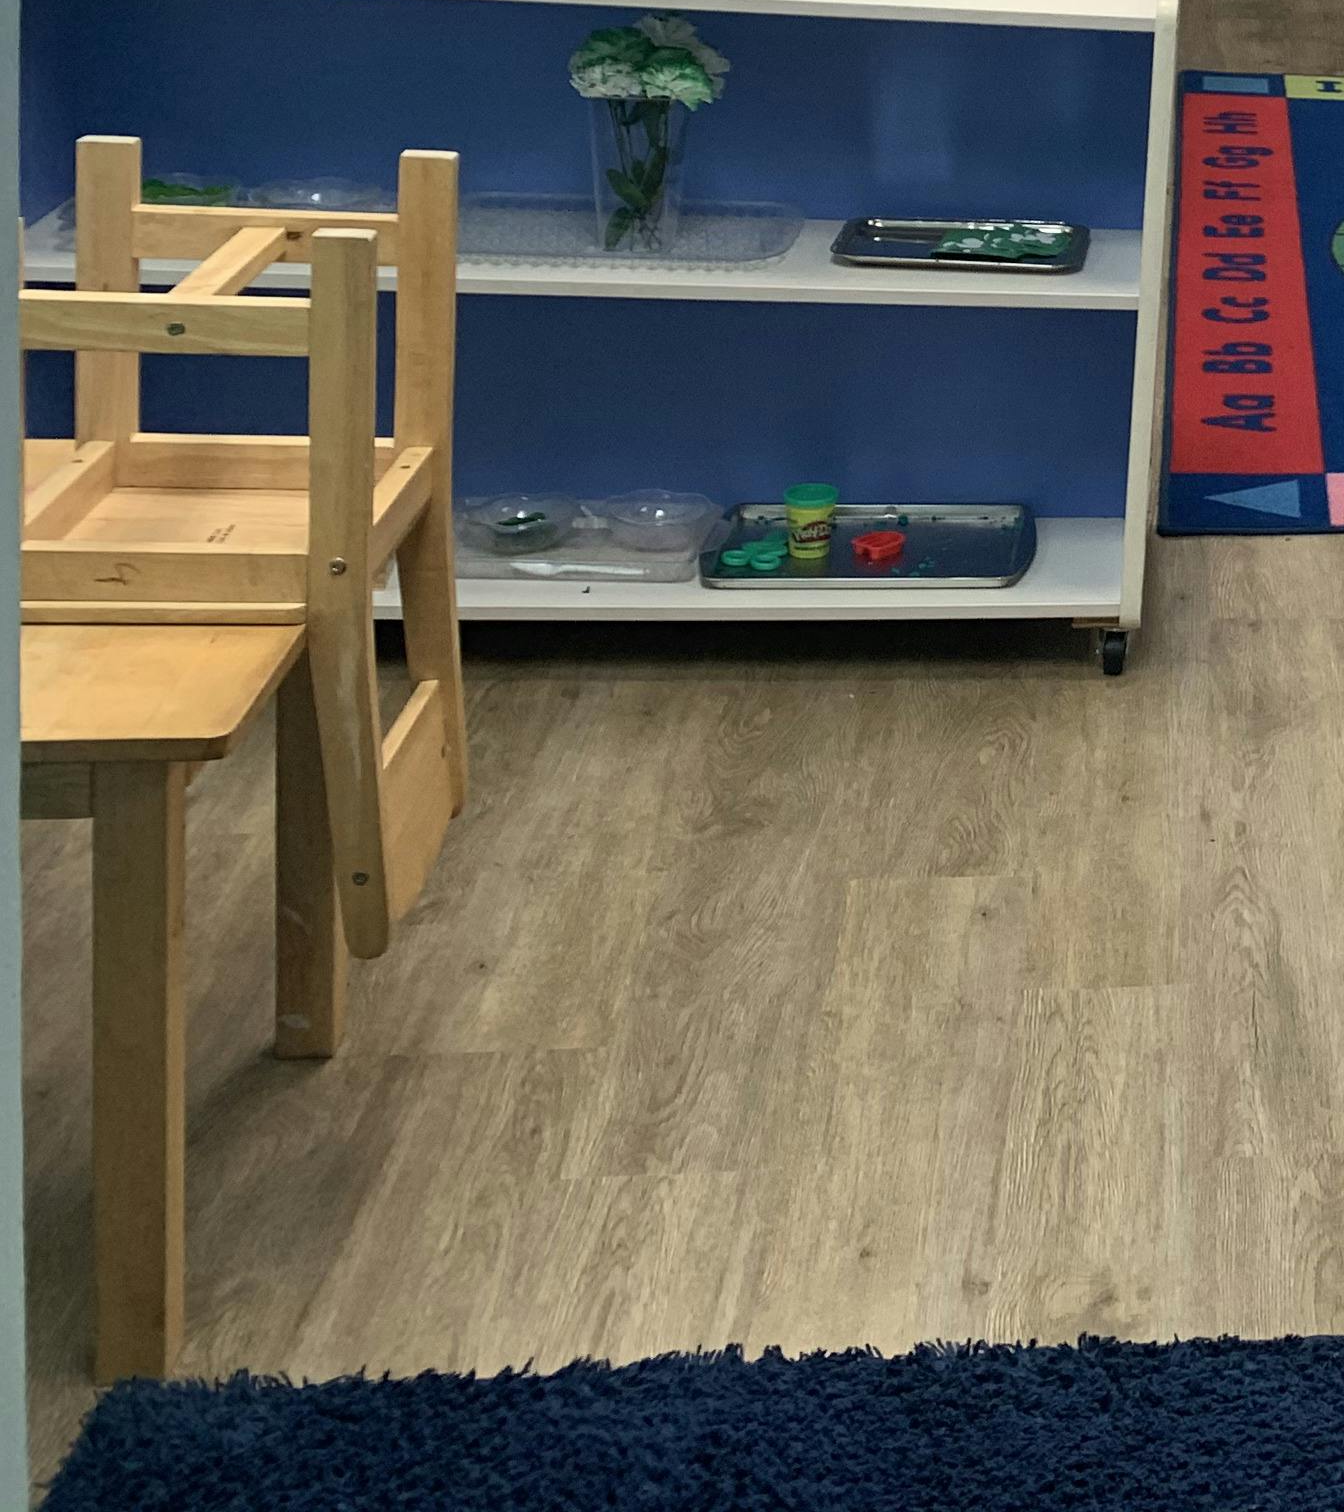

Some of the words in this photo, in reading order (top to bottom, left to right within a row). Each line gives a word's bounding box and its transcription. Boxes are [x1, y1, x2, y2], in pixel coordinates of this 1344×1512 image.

[1202, 111, 1259, 135] Hh
[1203, 145, 1275, 169] Gg
[1203, 179, 1263, 202] Ff
[1203, 215, 1265, 238] Ee
[1202, 252, 1268, 282] Dd
[1202, 296, 1271, 324] Cc
[1202, 342, 1274, 374] Bb
[1201, 393, 1278, 432] Aa
